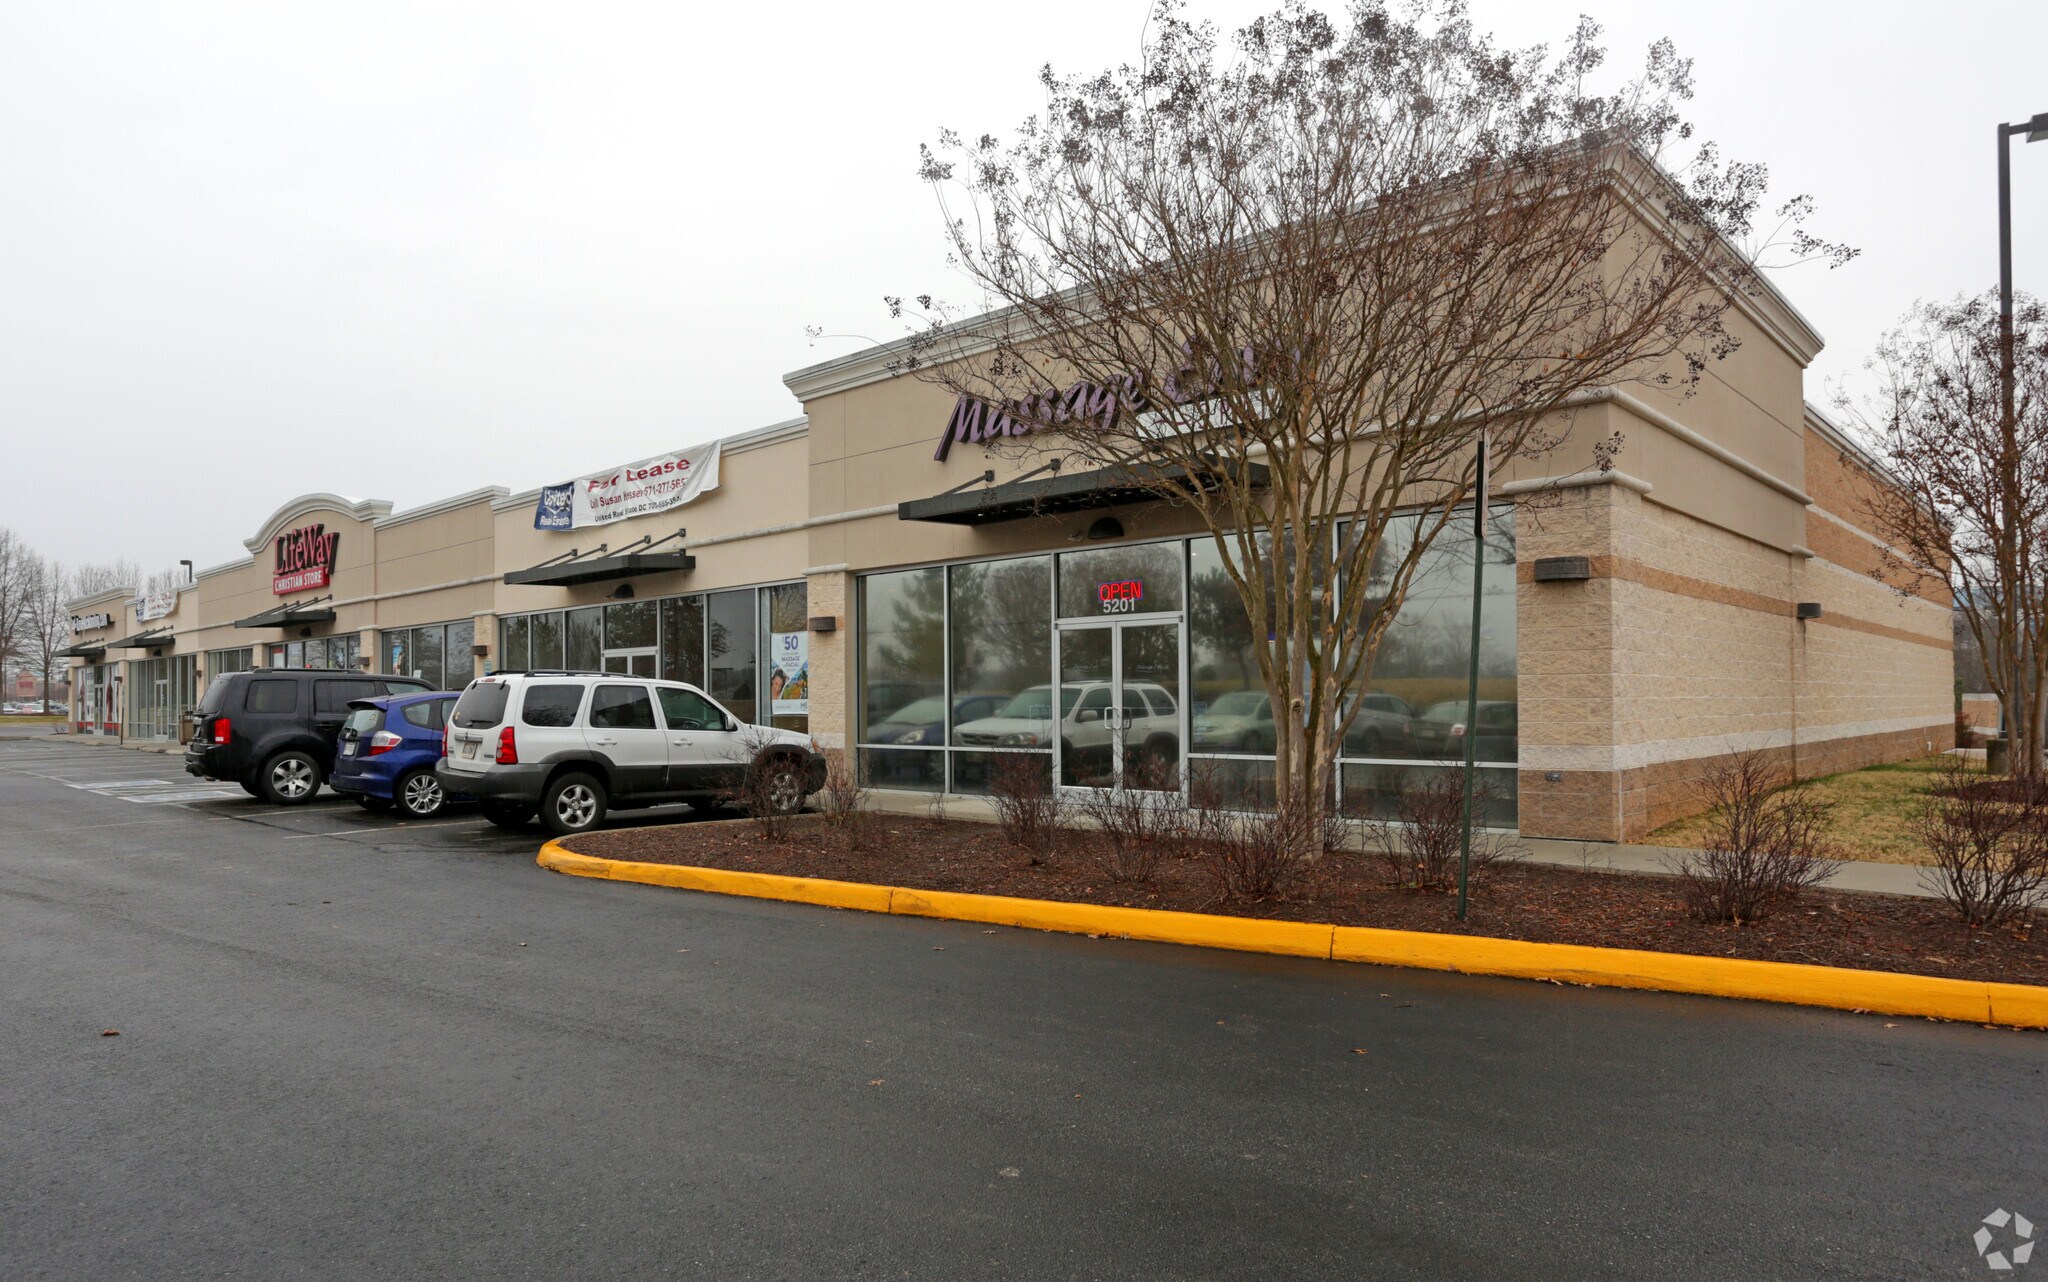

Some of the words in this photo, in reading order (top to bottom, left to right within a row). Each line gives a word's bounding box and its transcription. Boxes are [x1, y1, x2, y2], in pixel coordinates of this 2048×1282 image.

[934, 367, 1146, 462] Massage
[588, 475, 619, 492] For
[626, 458, 690, 481] Lease
[600, 494, 622, 507] Susan
[638, 503, 647, 511] DC
[275, 575, 303, 592] CHRISTIAN
[304, 570, 322, 586] STORE
[1099, 580, 1142, 600] OPEN
[1103, 597, 1135, 613] 5201
